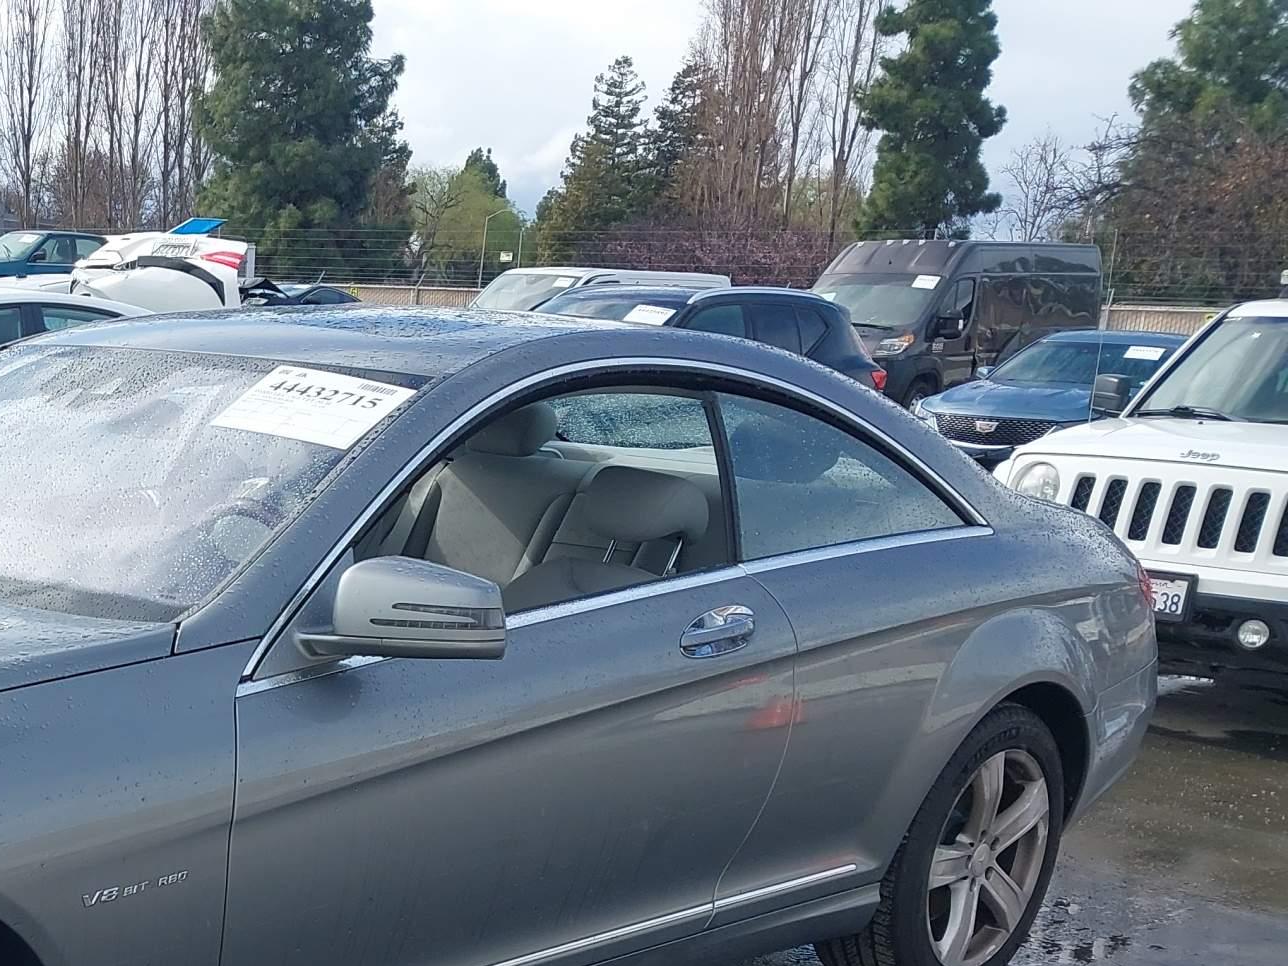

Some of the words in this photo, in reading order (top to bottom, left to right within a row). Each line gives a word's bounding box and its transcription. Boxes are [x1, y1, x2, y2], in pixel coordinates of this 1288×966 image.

[269, 380, 383, 409] 44432715
[1179, 449, 1220, 461] Jeep
[81, 886, 119, 908] V8
